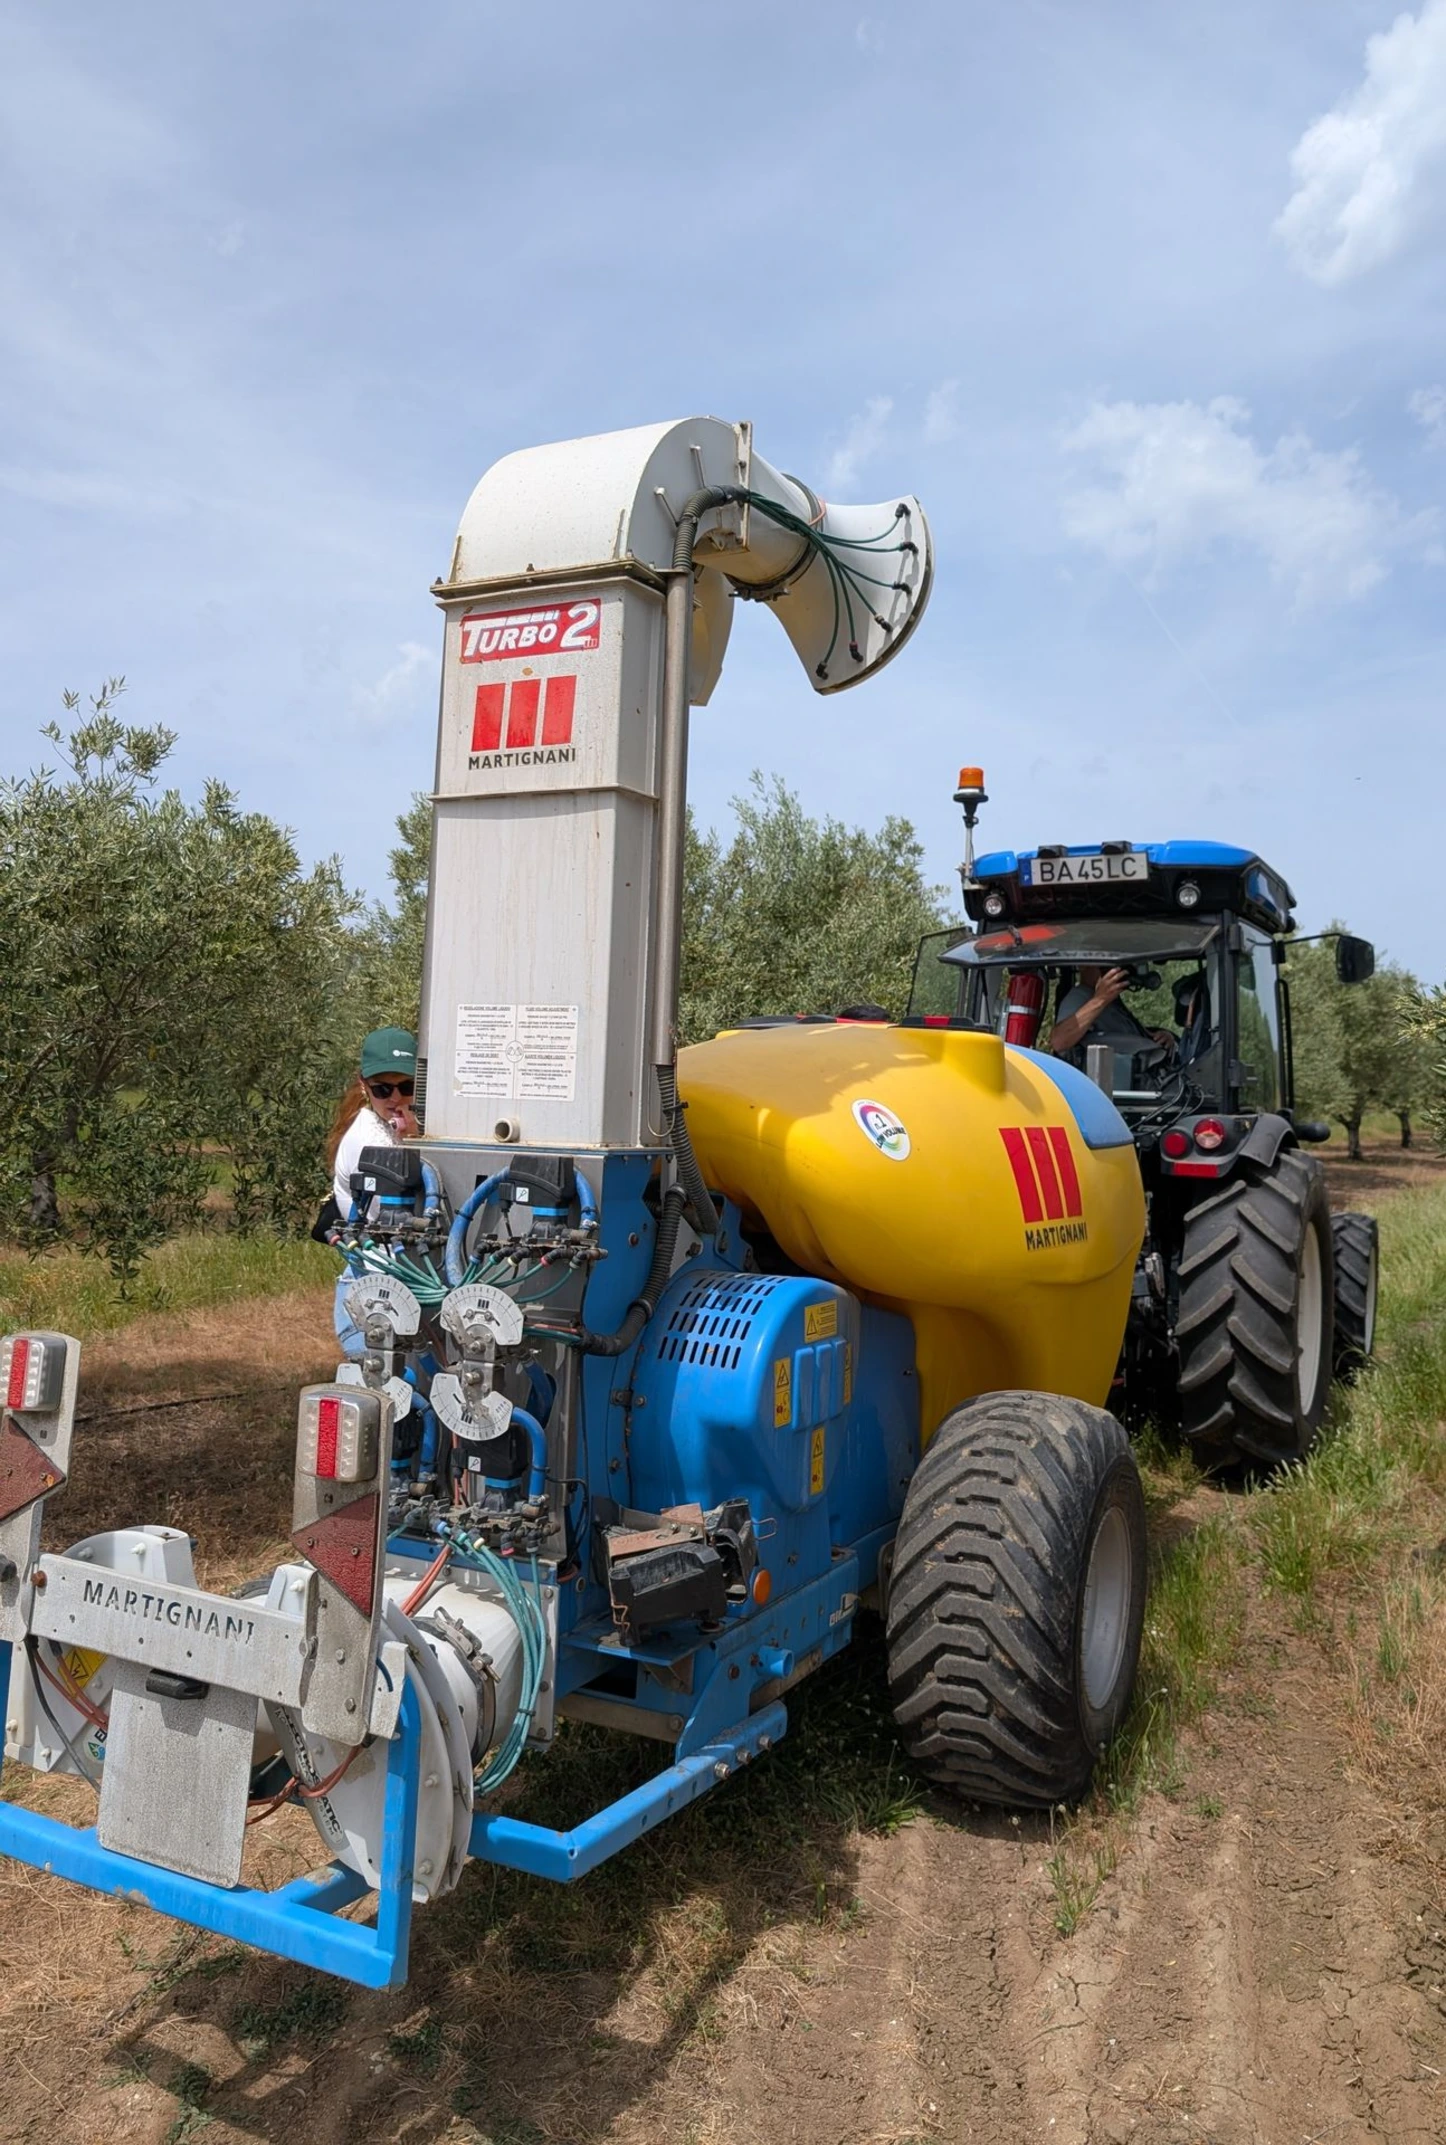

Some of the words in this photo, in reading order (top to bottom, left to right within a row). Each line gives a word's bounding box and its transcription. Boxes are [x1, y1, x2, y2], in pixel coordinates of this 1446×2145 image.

[463, 611, 559, 657] TURBO
[560, 601, 598, 648] 2
[468, 748, 576, 771] MARTIGNANI
[1024, 1222, 1088, 1251] MARTIGNANI
[83, 1579, 256, 1646] MARTIGNANI
